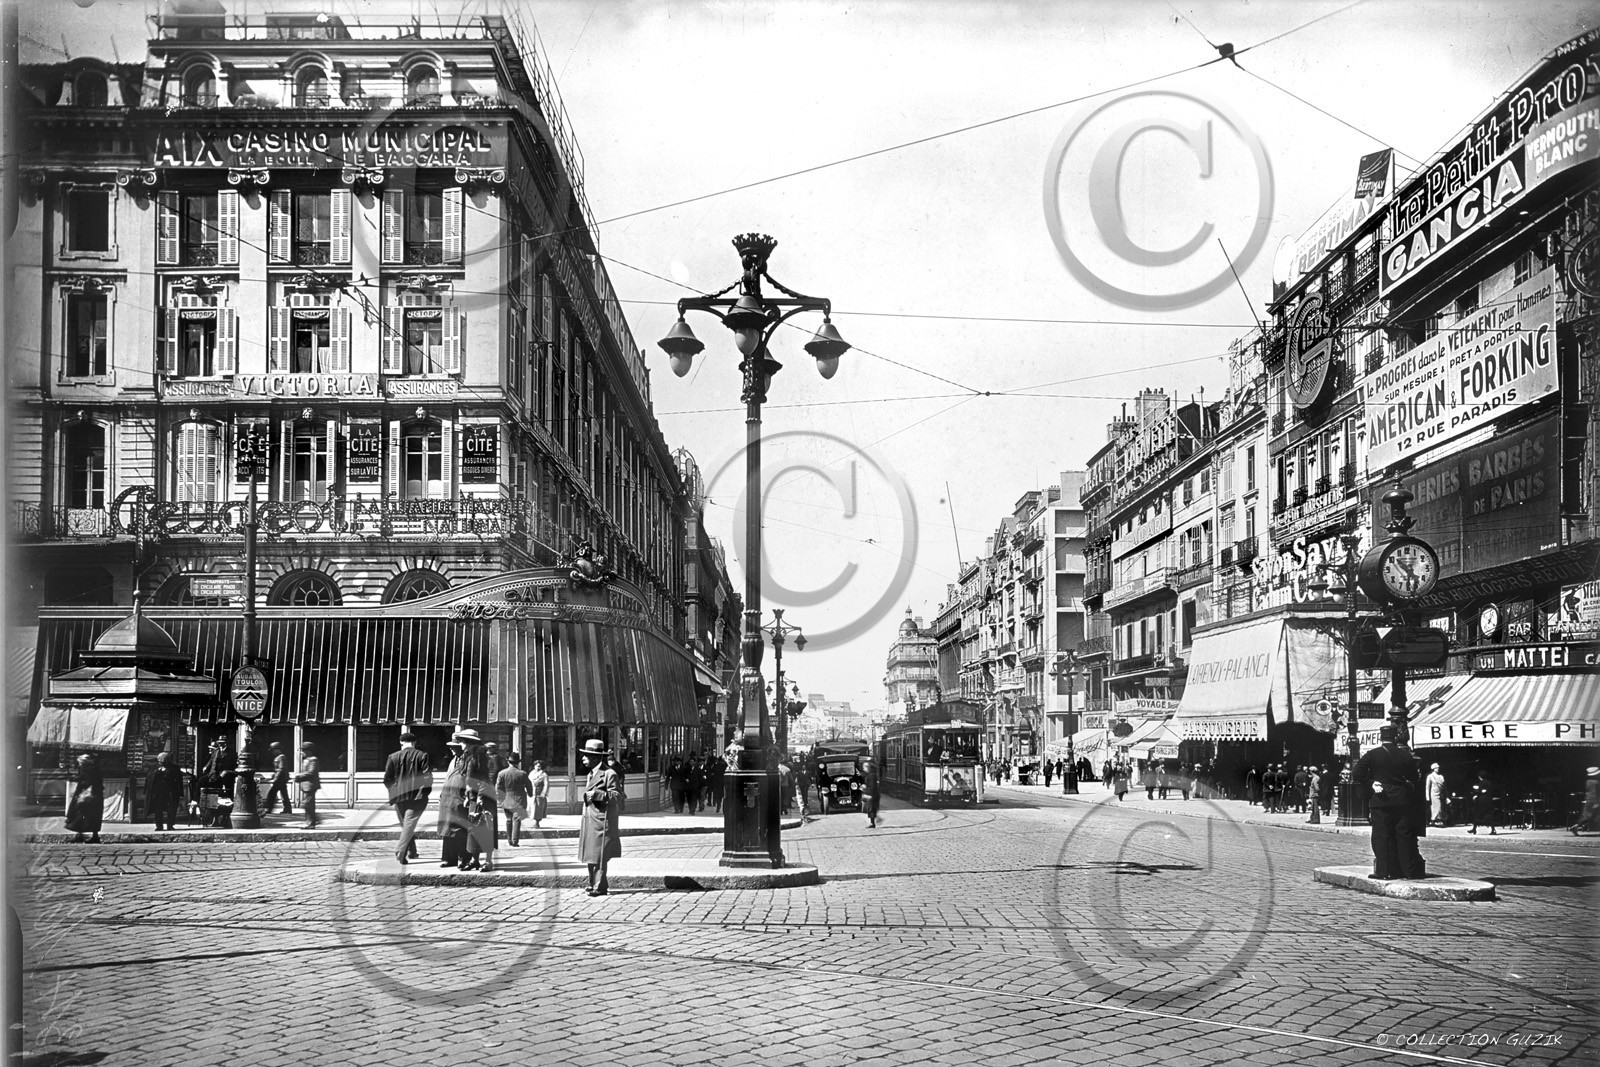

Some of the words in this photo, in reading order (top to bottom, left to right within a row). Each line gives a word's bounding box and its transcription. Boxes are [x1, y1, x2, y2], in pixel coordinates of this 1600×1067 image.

[154, 131, 223, 167] AIX
[227, 132, 331, 153] CASINO
[342, 131, 491, 153] MUNICIPAL
[1525, 108, 1600, 161] VERMOUTH
[343, 153, 365, 167] LE
[374, 153, 471, 167] BACCARA
[1535, 134, 1588, 175] BLANC
[1390, 189, 1425, 242] Le
[1427, 116, 1501, 216] Petit
[1298, 187, 1378, 275] BERTIMAY
[1386, 159, 1523, 282] GANCIA
[1418, 347, 1437, 370] dans
[1498, 304, 1516, 329] pour
[1517, 283, 1552, 316] Hommes
[1384, 388, 1400, 403] SUR
[1403, 368, 1438, 393] MESURE
[1483, 321, 1523, 350] PORTER
[164, 382, 231, 396] ASSURANCES
[238, 375, 375, 396] VICTORIA
[389, 382, 456, 394] ASSURANCES
[1369, 379, 1446, 450] AMERICAN
[1450, 391, 1457, 409] &
[1460, 324, 1551, 406] FORKING
[358, 428, 372, 436] LA
[1397, 437, 1412, 452] 12
[1416, 422, 1445, 443] RUE
[1451, 388, 1518, 428] PARADIS
[351, 436, 378, 453] CITÉ
[466, 436, 493, 452] CITÉ
[350, 468, 360, 476] SUR
[366, 466, 378, 476] VIE
[1404, 467, 1460, 512] LERIES
[1473, 497, 1486, 517] DE
[1490, 471, 1545, 511] PARIS
[1450, 572, 1532, 601] HORLOGERS
[1507, 622, 1531, 637] BAR
[1187, 652, 1270, 685] LORENZY-PALANCA
[1480, 658, 1495, 669] UN
[1504, 646, 1569, 668] MATTEI
[236, 701, 263, 711] NICE
[1183, 721, 1259, 737] PARFUMERIE
[1431, 724, 1518, 740] BIERE
[1555, 723, 1595, 739] PH
